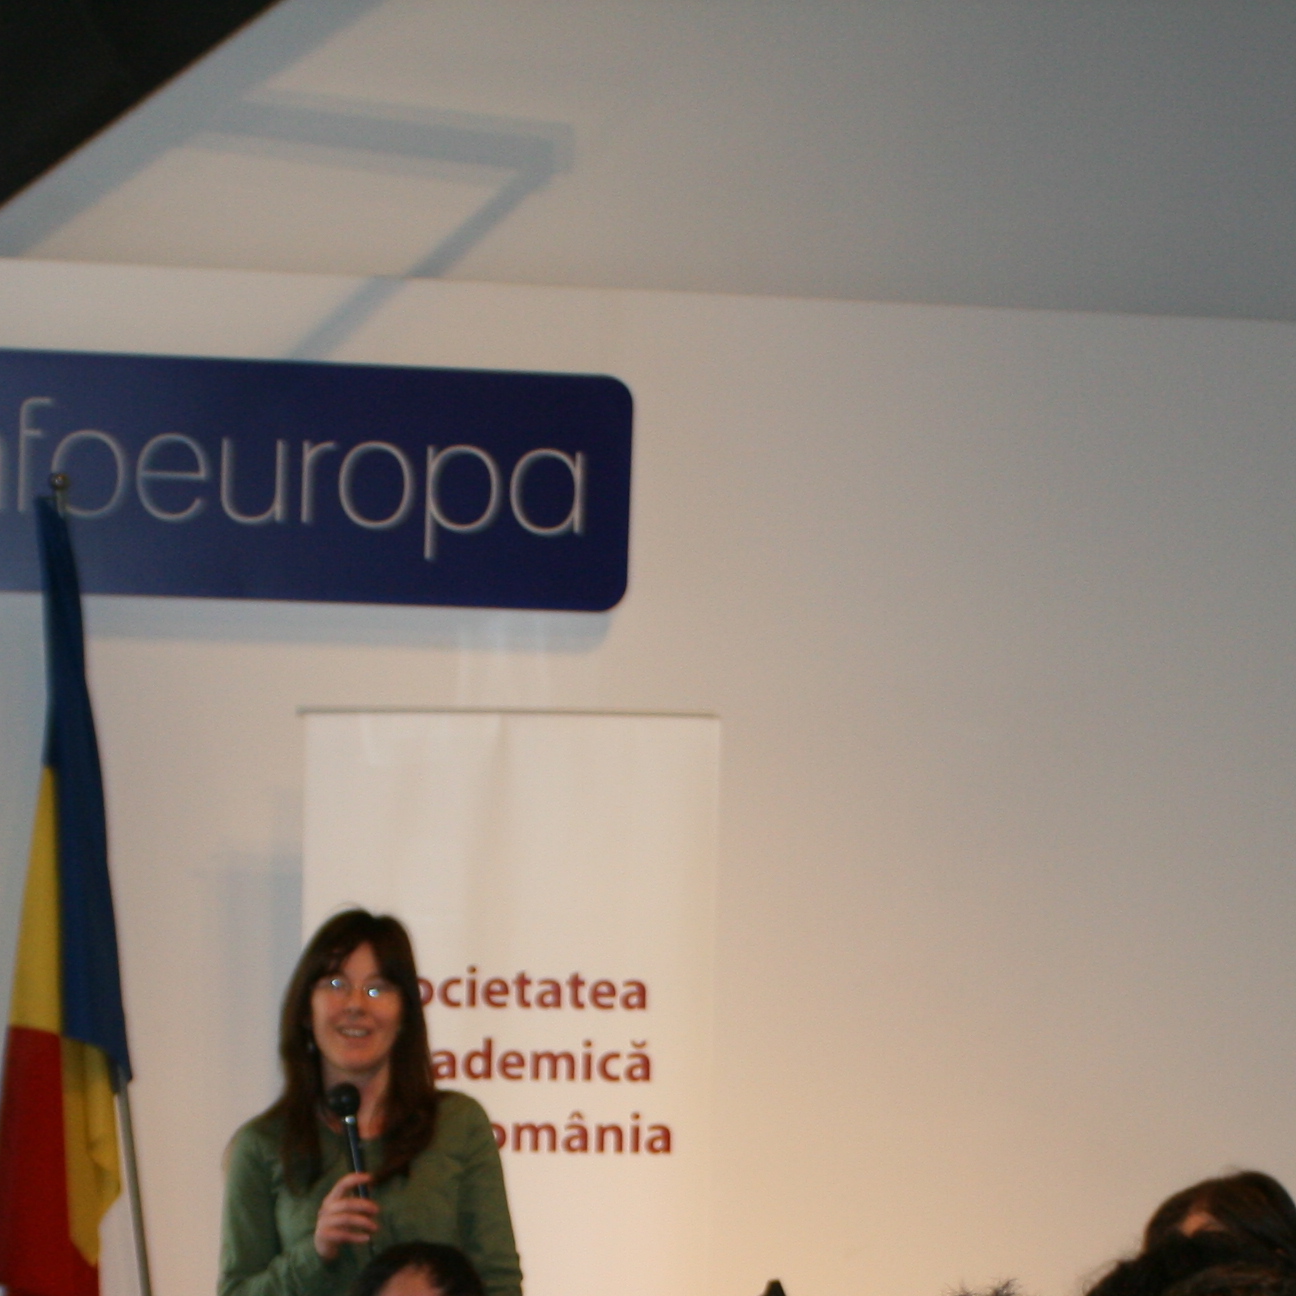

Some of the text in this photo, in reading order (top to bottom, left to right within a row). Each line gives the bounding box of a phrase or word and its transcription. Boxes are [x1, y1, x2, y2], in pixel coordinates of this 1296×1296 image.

[417, 965, 648, 1010] ocietatea
[432, 1036, 652, 1083] ademică
[491, 1110, 672, 1155] omânia
